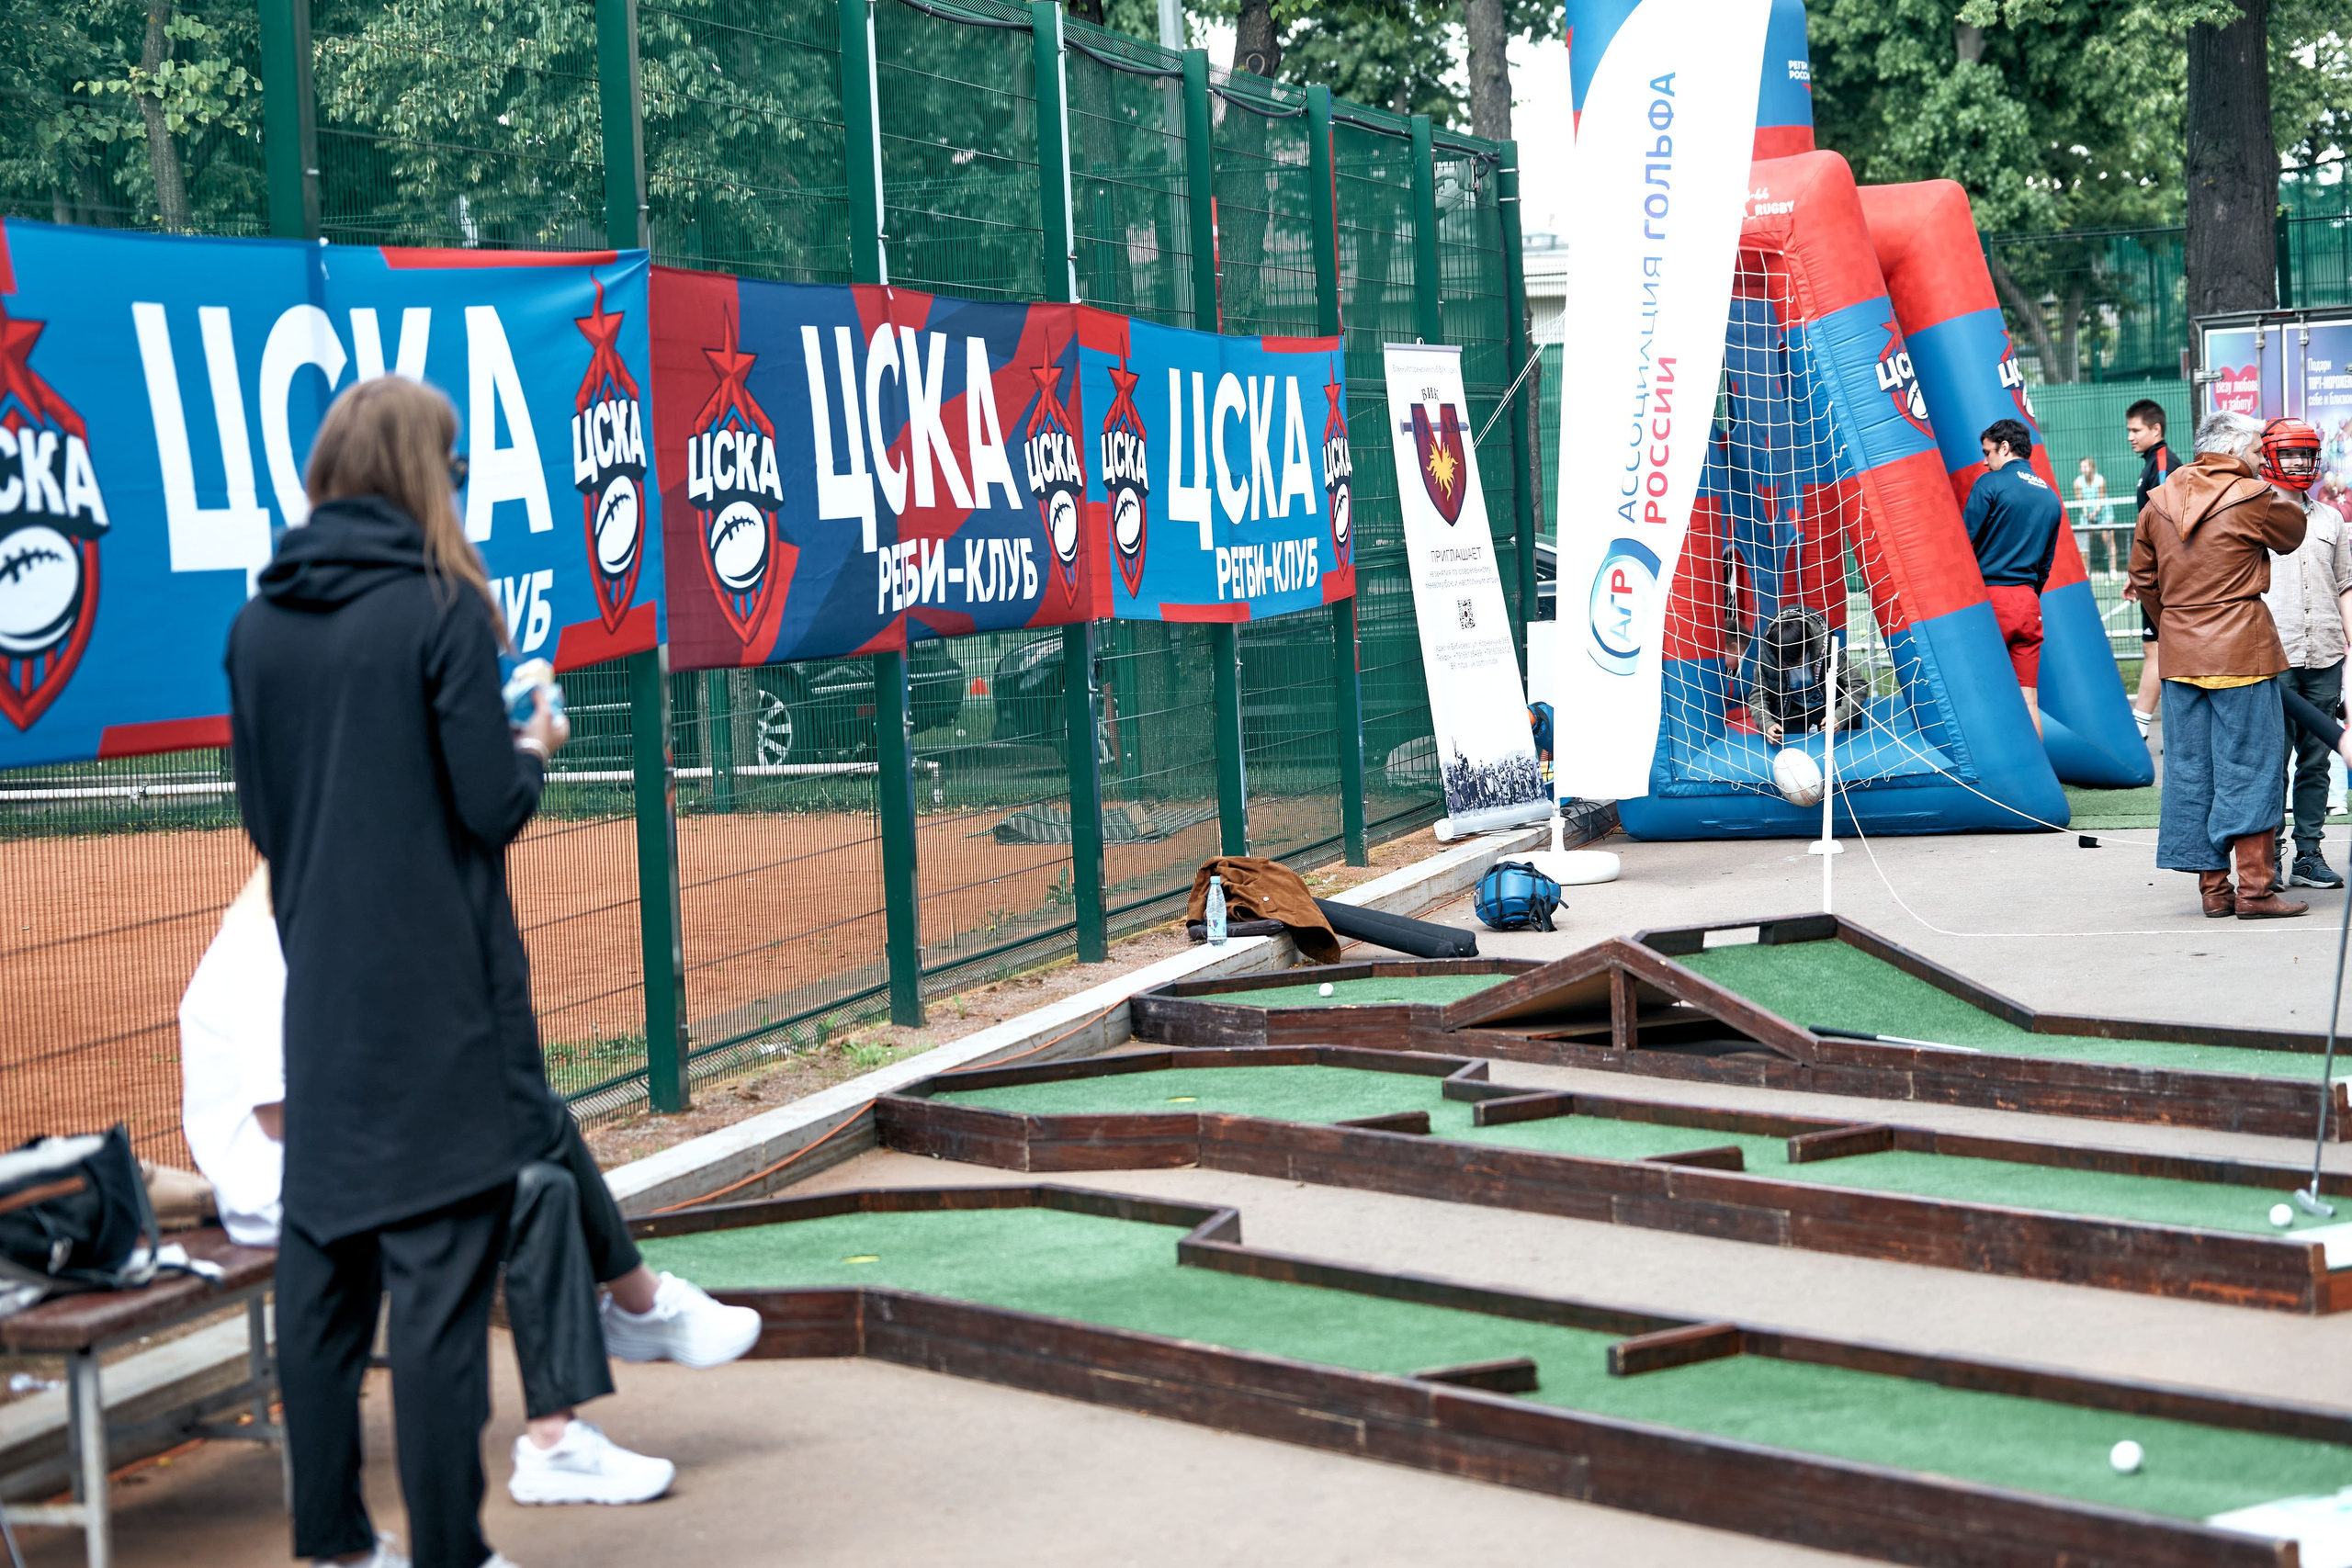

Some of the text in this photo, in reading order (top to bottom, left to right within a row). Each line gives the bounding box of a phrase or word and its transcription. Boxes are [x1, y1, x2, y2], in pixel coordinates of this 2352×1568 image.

[1644, 72, 1676, 240] ГОЛЬФА
[1874, 351, 1916, 391] ЦС
[2215, 380, 2233, 395] Везу
[2307, 357, 2332, 373] Подари
[131, 301, 553, 599] ЦСА
[571, 399, 647, 485] ЦСКА
[688, 429, 784, 502] ЦСКА
[800, 321, 1023, 553] ЦСКА
[1024, 432, 1083, 493] ЦСКА
[1101, 431, 1149, 491] ЦСКА
[1168, 367, 1317, 550] ЦСКА
[1322, 436, 1352, 488] ЦСКА
[1644, 356, 1678, 525] РОССИИ
[1216, 536, 1318, 600] РЕГБИ-КЛУБ
[1430, 547, 1481, 562] ПРИГЛАШАЕТ
